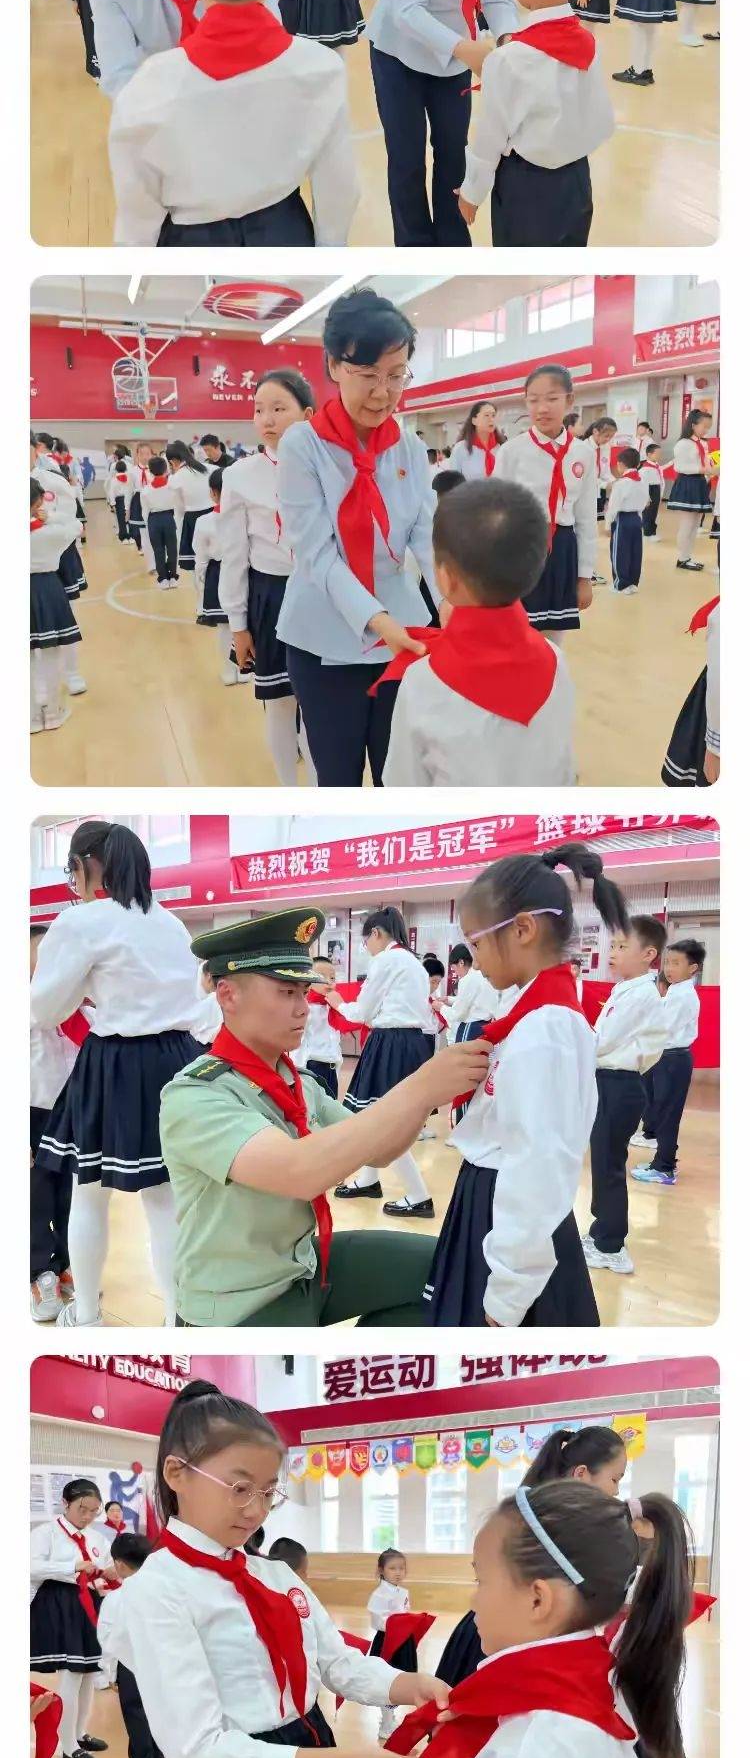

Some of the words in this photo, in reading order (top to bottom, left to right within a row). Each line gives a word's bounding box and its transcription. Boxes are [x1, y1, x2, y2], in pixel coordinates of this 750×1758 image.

[212, 392, 243, 401] NEVER
[248, 847, 331, 882] 热烈祝贺
[344, 817, 515, 868] “我们是冠军”
[113, 1357, 190, 1390] EDUCATIO
[323, 1355, 435, 1401] 爱运动
